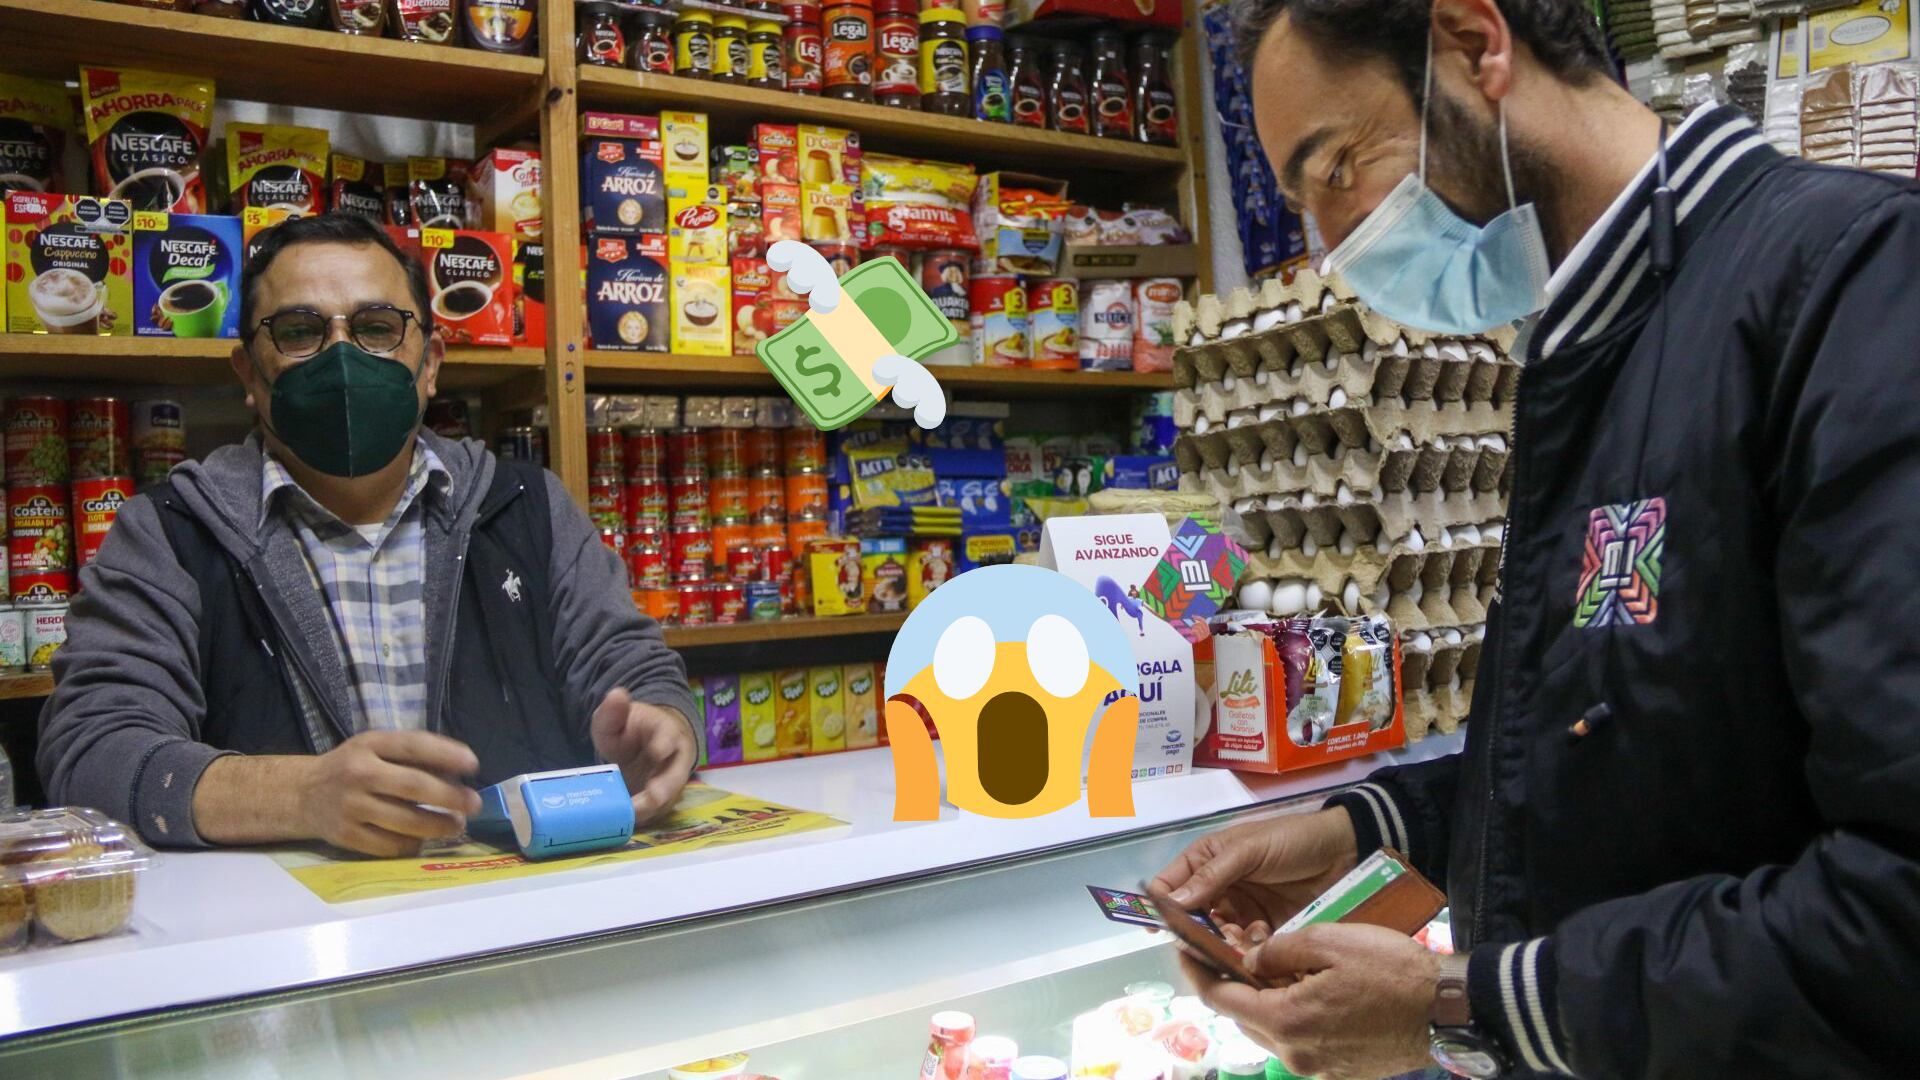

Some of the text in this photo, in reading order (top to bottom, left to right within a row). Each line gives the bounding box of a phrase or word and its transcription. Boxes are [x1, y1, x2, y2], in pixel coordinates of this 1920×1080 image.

[832, 21, 867, 39] Legal
[882, 32, 919, 53] Legal
[800, 41, 821, 63] Leg
[91, 93, 176, 124] AHORRA
[238, 148, 297, 170] AHORRA
[601, 176, 657, 196] ARROZ
[247, 213, 261, 225] $5
[425, 235, 444, 247] $10
[43, 246, 97, 260] Cappuccino
[167, 253, 211, 267] Decaf
[52, 260, 89, 269] ORIGINAL
[597, 281, 665, 305] ARROZ
[1012, 289, 1024, 309] 3
[1062, 289, 1073, 306] 3
[33, 498, 47, 507] La
[107, 492, 120, 501] La
[87, 513, 105, 522] ELOTE
[1094, 533, 1134, 546] SIGUE
[1075, 546, 1159, 561] AVANZANDO
[34, 586, 48, 595] La
[1103, 676, 1163, 706] AUÍ
[565, 787, 604, 798] mercado
[568, 796, 591, 807] pago
